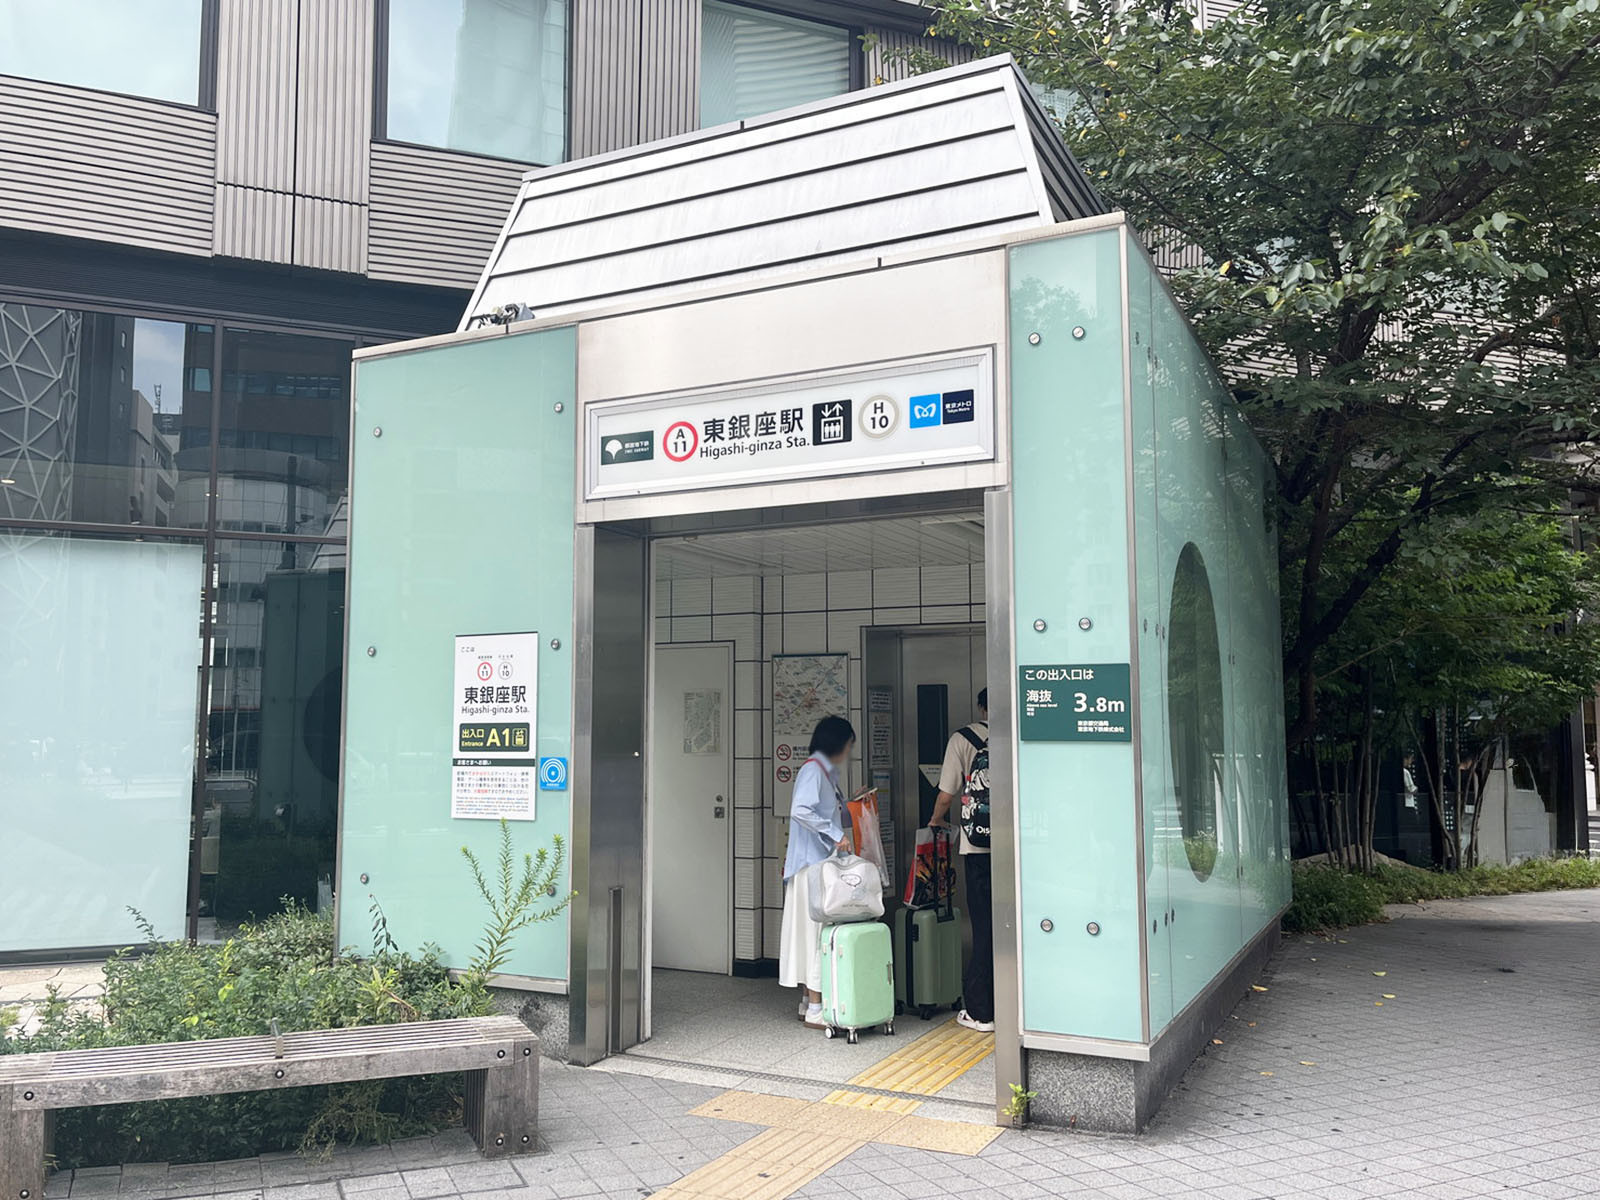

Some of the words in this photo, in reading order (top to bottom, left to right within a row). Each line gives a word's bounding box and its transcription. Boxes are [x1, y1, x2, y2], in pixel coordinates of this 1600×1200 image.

[873, 402, 884, 414] H
[703, 407, 803, 443] 東銀座駅
[870, 415, 889, 430] 10
[676, 428, 685, 440] A
[673, 440, 687, 453] 11
[700, 439, 782, 460] Higashi-ginza
[786, 435, 810, 449] Sta.
[1025, 669, 1094, 680] この出入口は
[464, 685, 527, 704] 東銀座駅
[1026, 690, 1052, 703] 海抜
[1073, 692, 1125, 713] 3.8m
[461, 705, 513, 716] Higashi-ginza
[515, 705, 530, 713] Sta.
[461, 728, 485, 739] 出入口
[486, 728, 510, 747] A1
